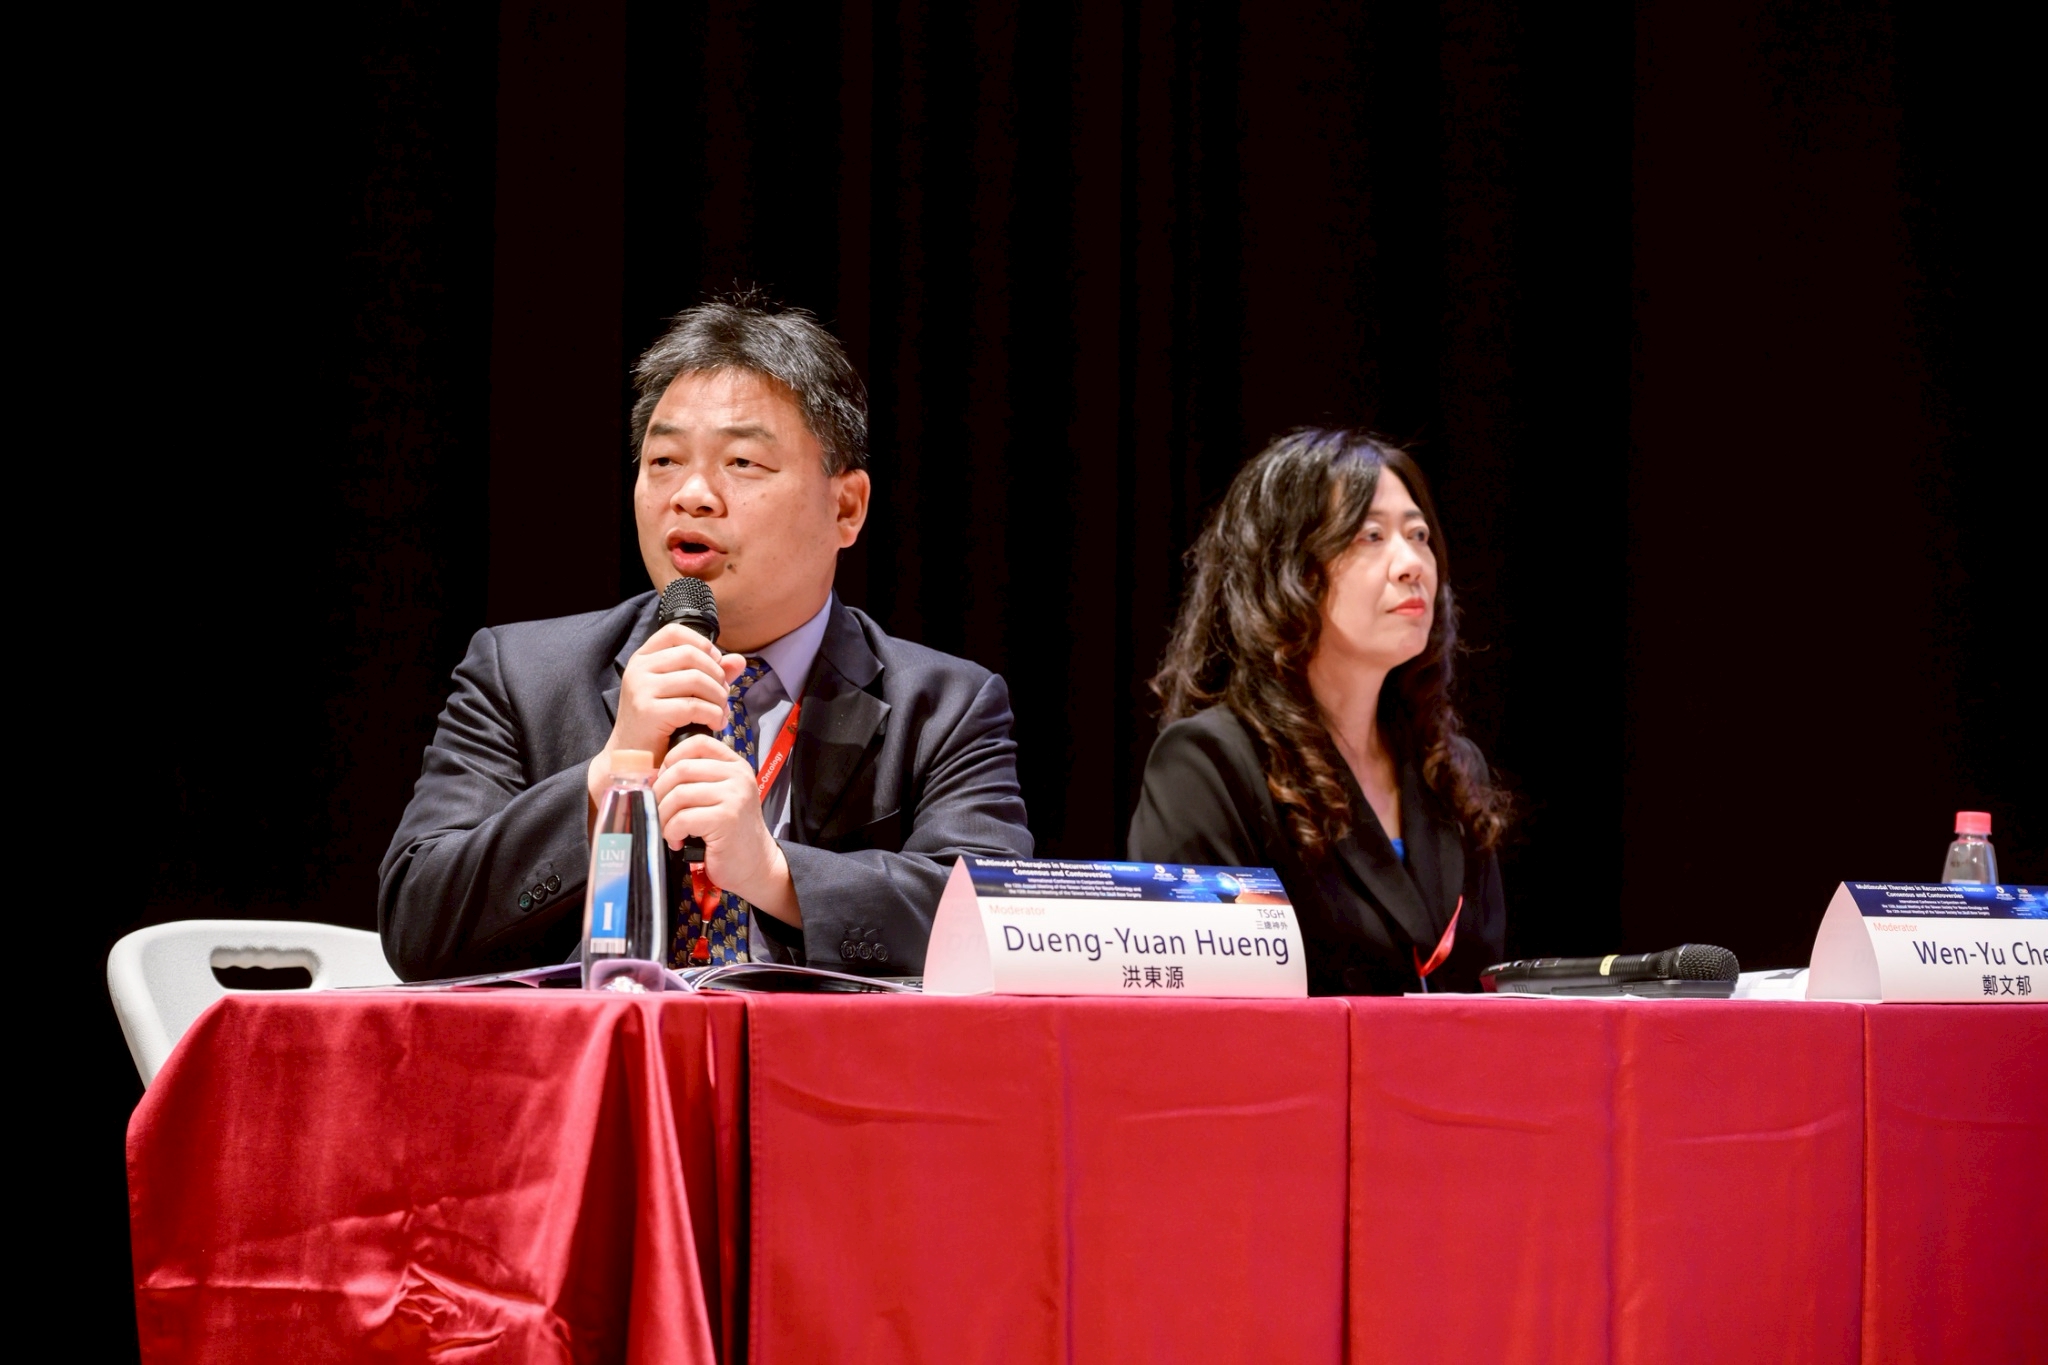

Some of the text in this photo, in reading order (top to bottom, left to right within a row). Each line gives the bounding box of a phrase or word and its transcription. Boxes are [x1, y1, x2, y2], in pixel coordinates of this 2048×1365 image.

[758, 752, 783, 796] ro-Oncology
[600, 849, 626, 861] UNI
[975, 858, 1017, 867] Multimodal
[1016, 860, 1052, 870] Therapies
[1051, 861, 1060, 869] in
[1060, 862, 1094, 870] Recurrent
[1093, 863, 1112, 871] Brain
[1013, 868, 1112, 879] Consensus and Controversies
[1887, 884, 1915, 892] Therapies
[989, 904, 1046, 917] Moderator
[1257, 908, 1286, 919] TSGH
[1873, 922, 1918, 932] Moderator
[1003, 925, 1289, 965] Dueng-Yuan Hueng
[1912, 940, 2006, 966] Wen-Yu
[1123, 965, 1185, 989] 洪東源
[1982, 974, 2032, 996] 鄭文郁
